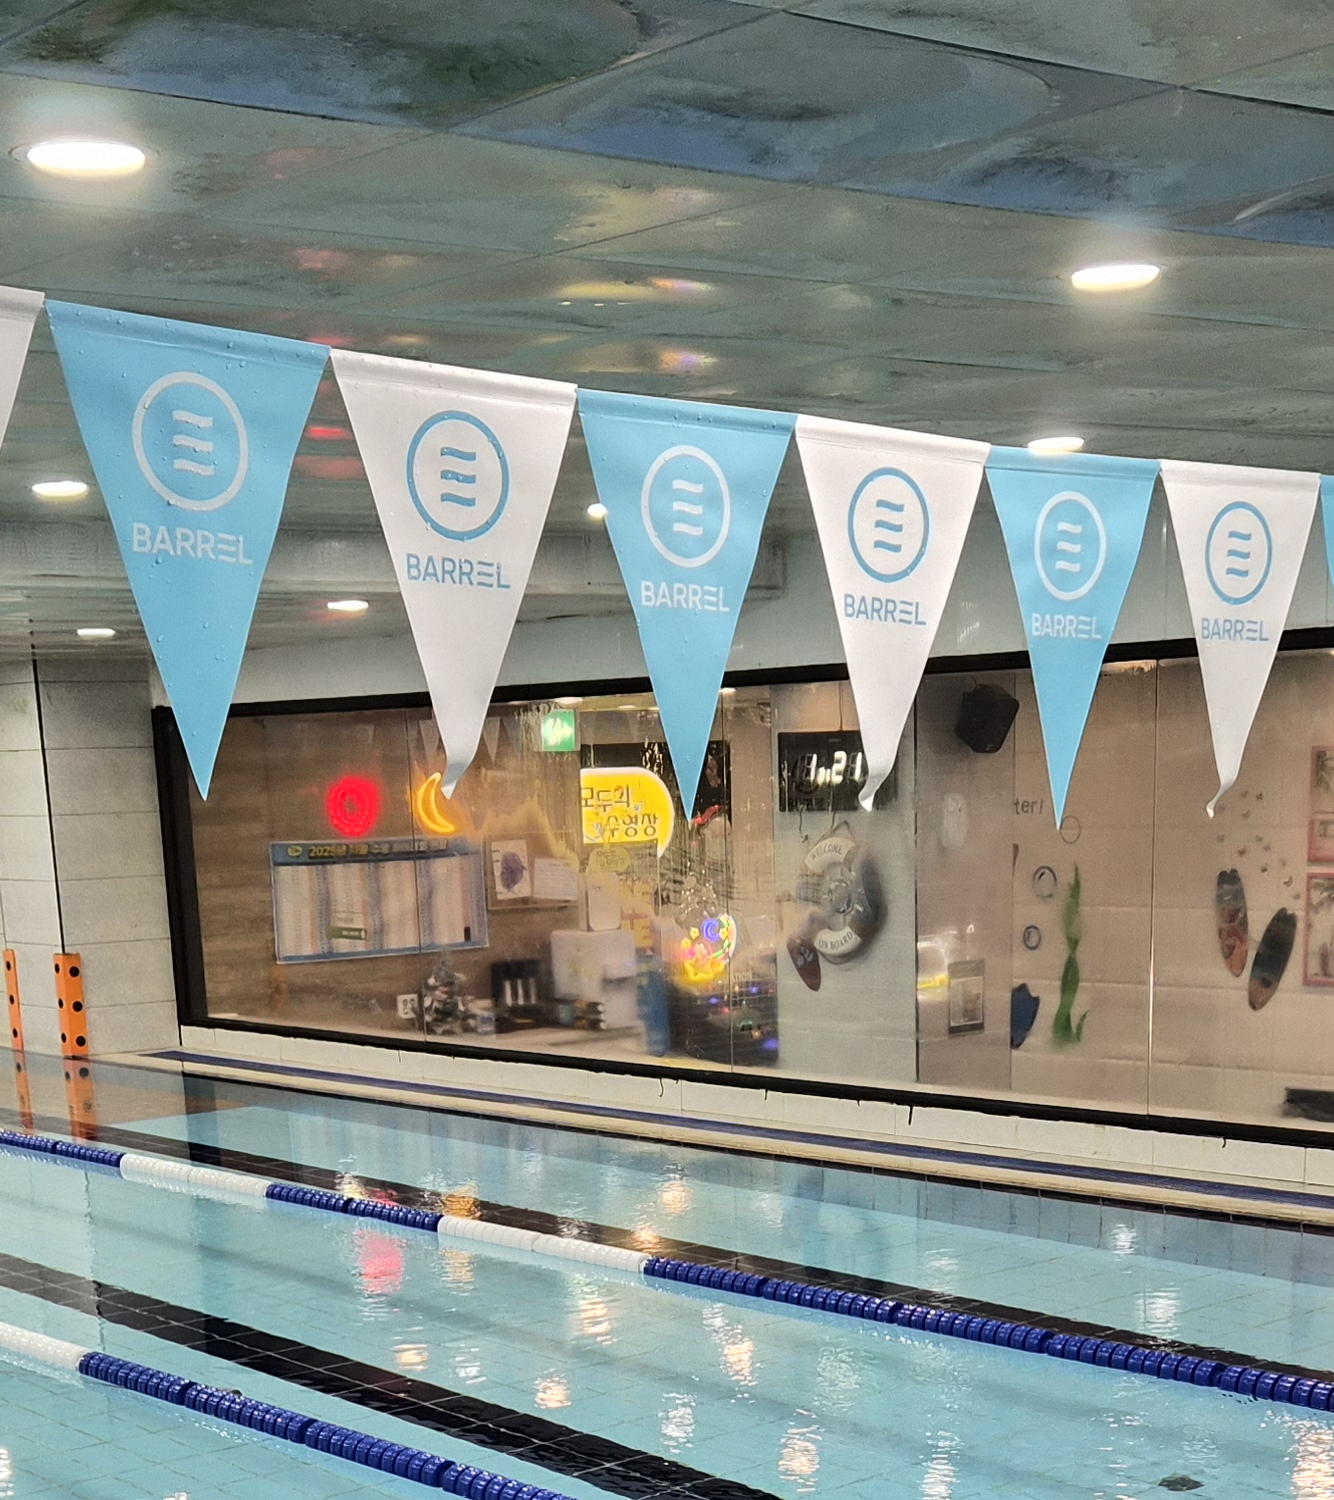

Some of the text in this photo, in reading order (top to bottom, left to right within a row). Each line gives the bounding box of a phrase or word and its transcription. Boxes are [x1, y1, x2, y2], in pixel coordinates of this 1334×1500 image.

[131, 522, 254, 566] BARREL
[406, 553, 511, 590] BARREL
[641, 580, 730, 613] BARREL
[843, 593, 927, 627] BARREL
[1031, 613, 1102, 640] BARREL
[1201, 616, 1269, 642] BARREL
